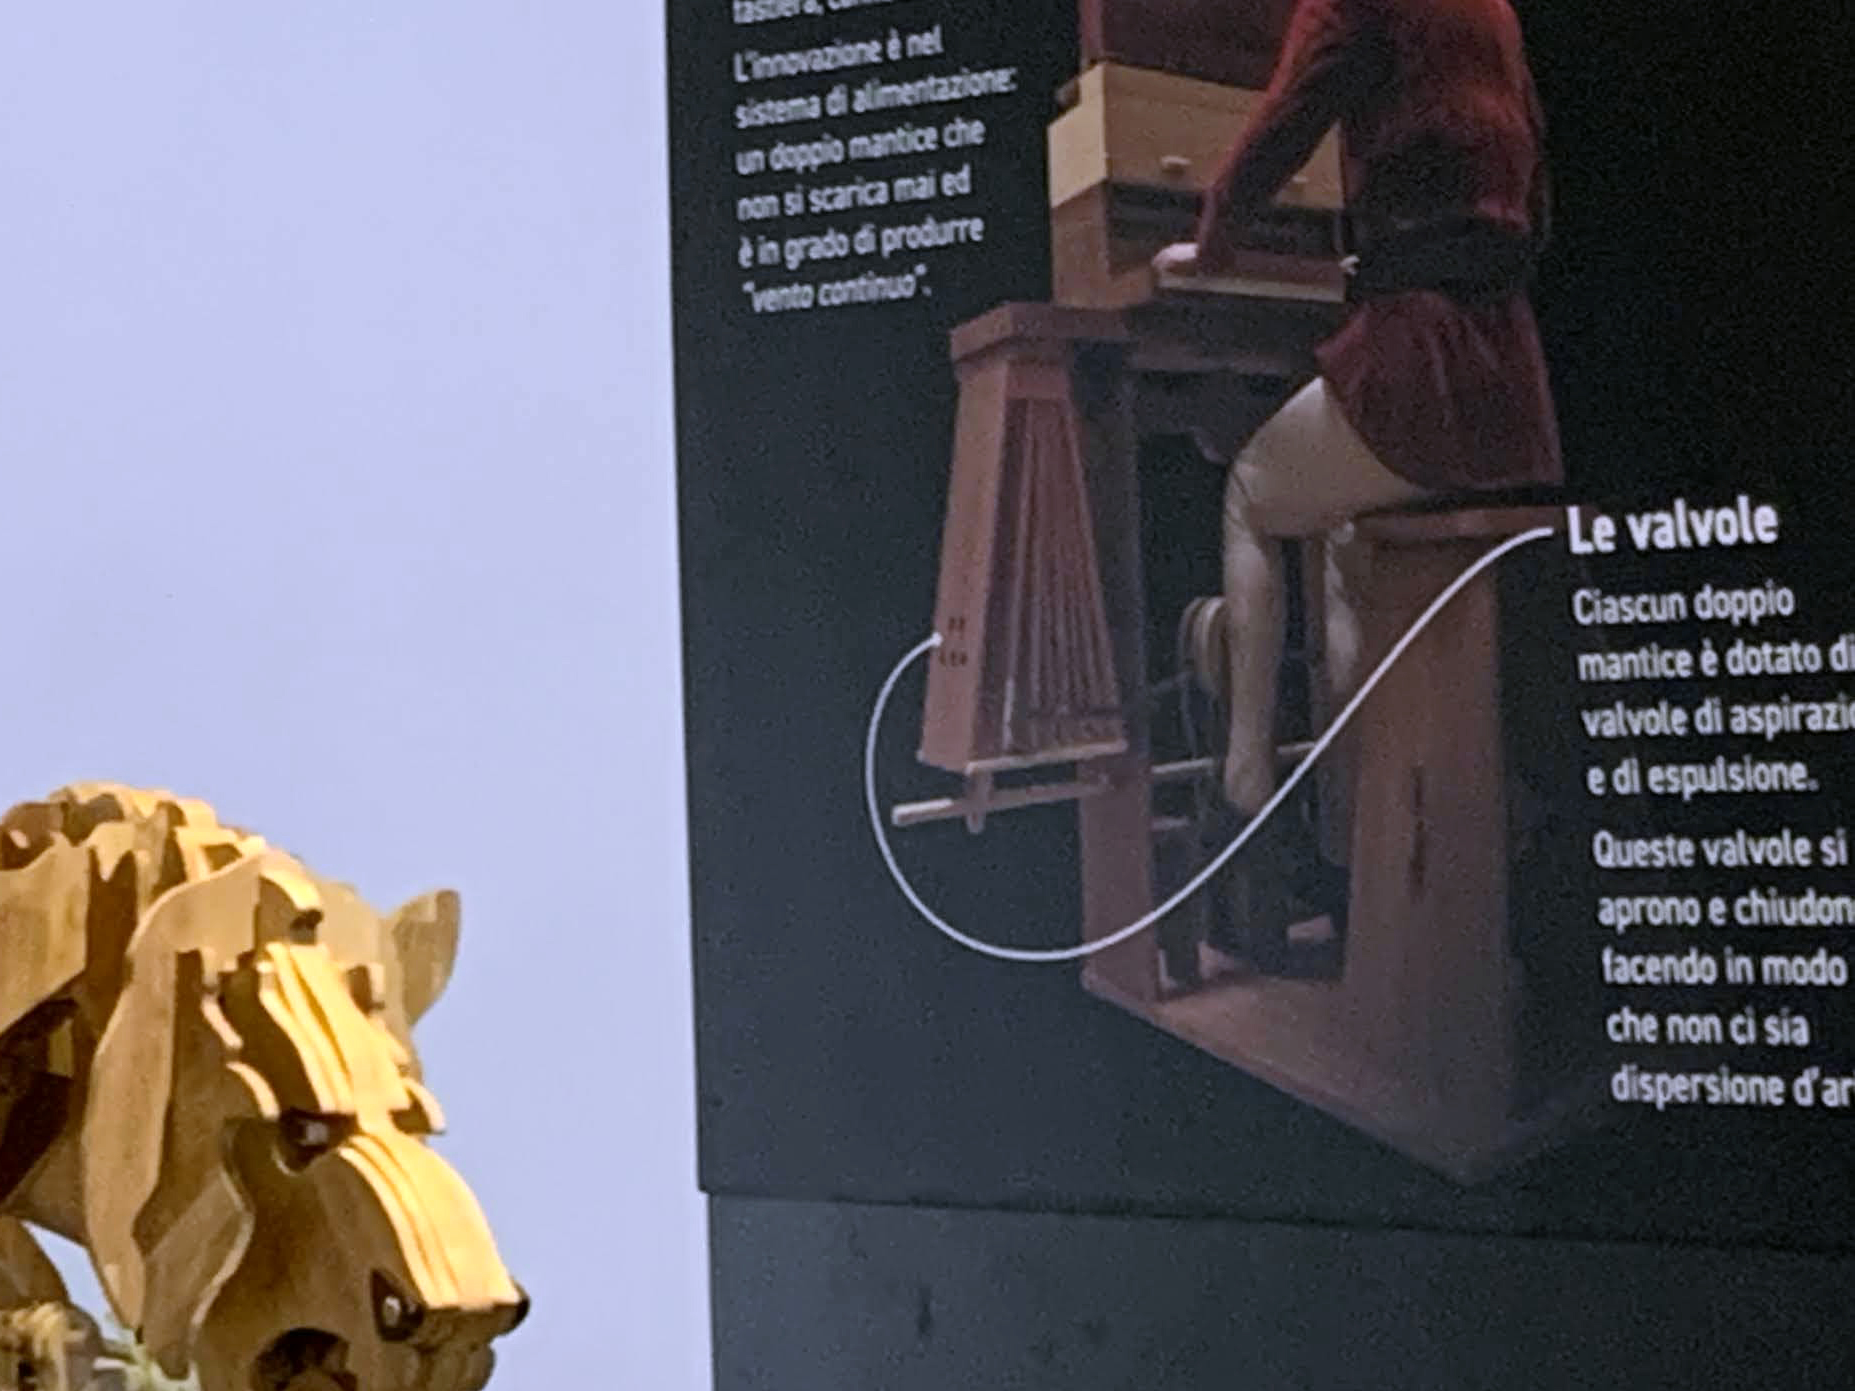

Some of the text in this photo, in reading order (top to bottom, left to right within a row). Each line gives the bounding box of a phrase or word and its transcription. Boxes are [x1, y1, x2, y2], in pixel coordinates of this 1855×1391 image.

[734, 39, 882, 82] L'innovazione
[907, 24, 944, 57] nel
[737, 67, 1017, 128] sistema di alimentazione:
[736, 117, 985, 174] un doppio mantice che
[738, 162, 970, 221] non si scarica mai ed
[739, 215, 984, 270] è in grado di produrre
[1566, 494, 1778, 554] Le valvole
[1573, 578, 1794, 627] Ciascun doppio
[1578, 633, 1855, 680] mantice è dotato di
[1581, 701, 1687, 737] valvole
[1695, 697, 1724, 735] di
[1587, 754, 1819, 801] e di espulsione.
[1593, 828, 1847, 868] Queste valvole si
[1598, 896, 1700, 935] aprono
[1708, 897, 1726, 926] e
[1602, 946, 1848, 986] facendo in modo
[1607, 1006, 1810, 1046] che non ci sia
[1612, 1064, 1855, 1111] dispersione d'ar
